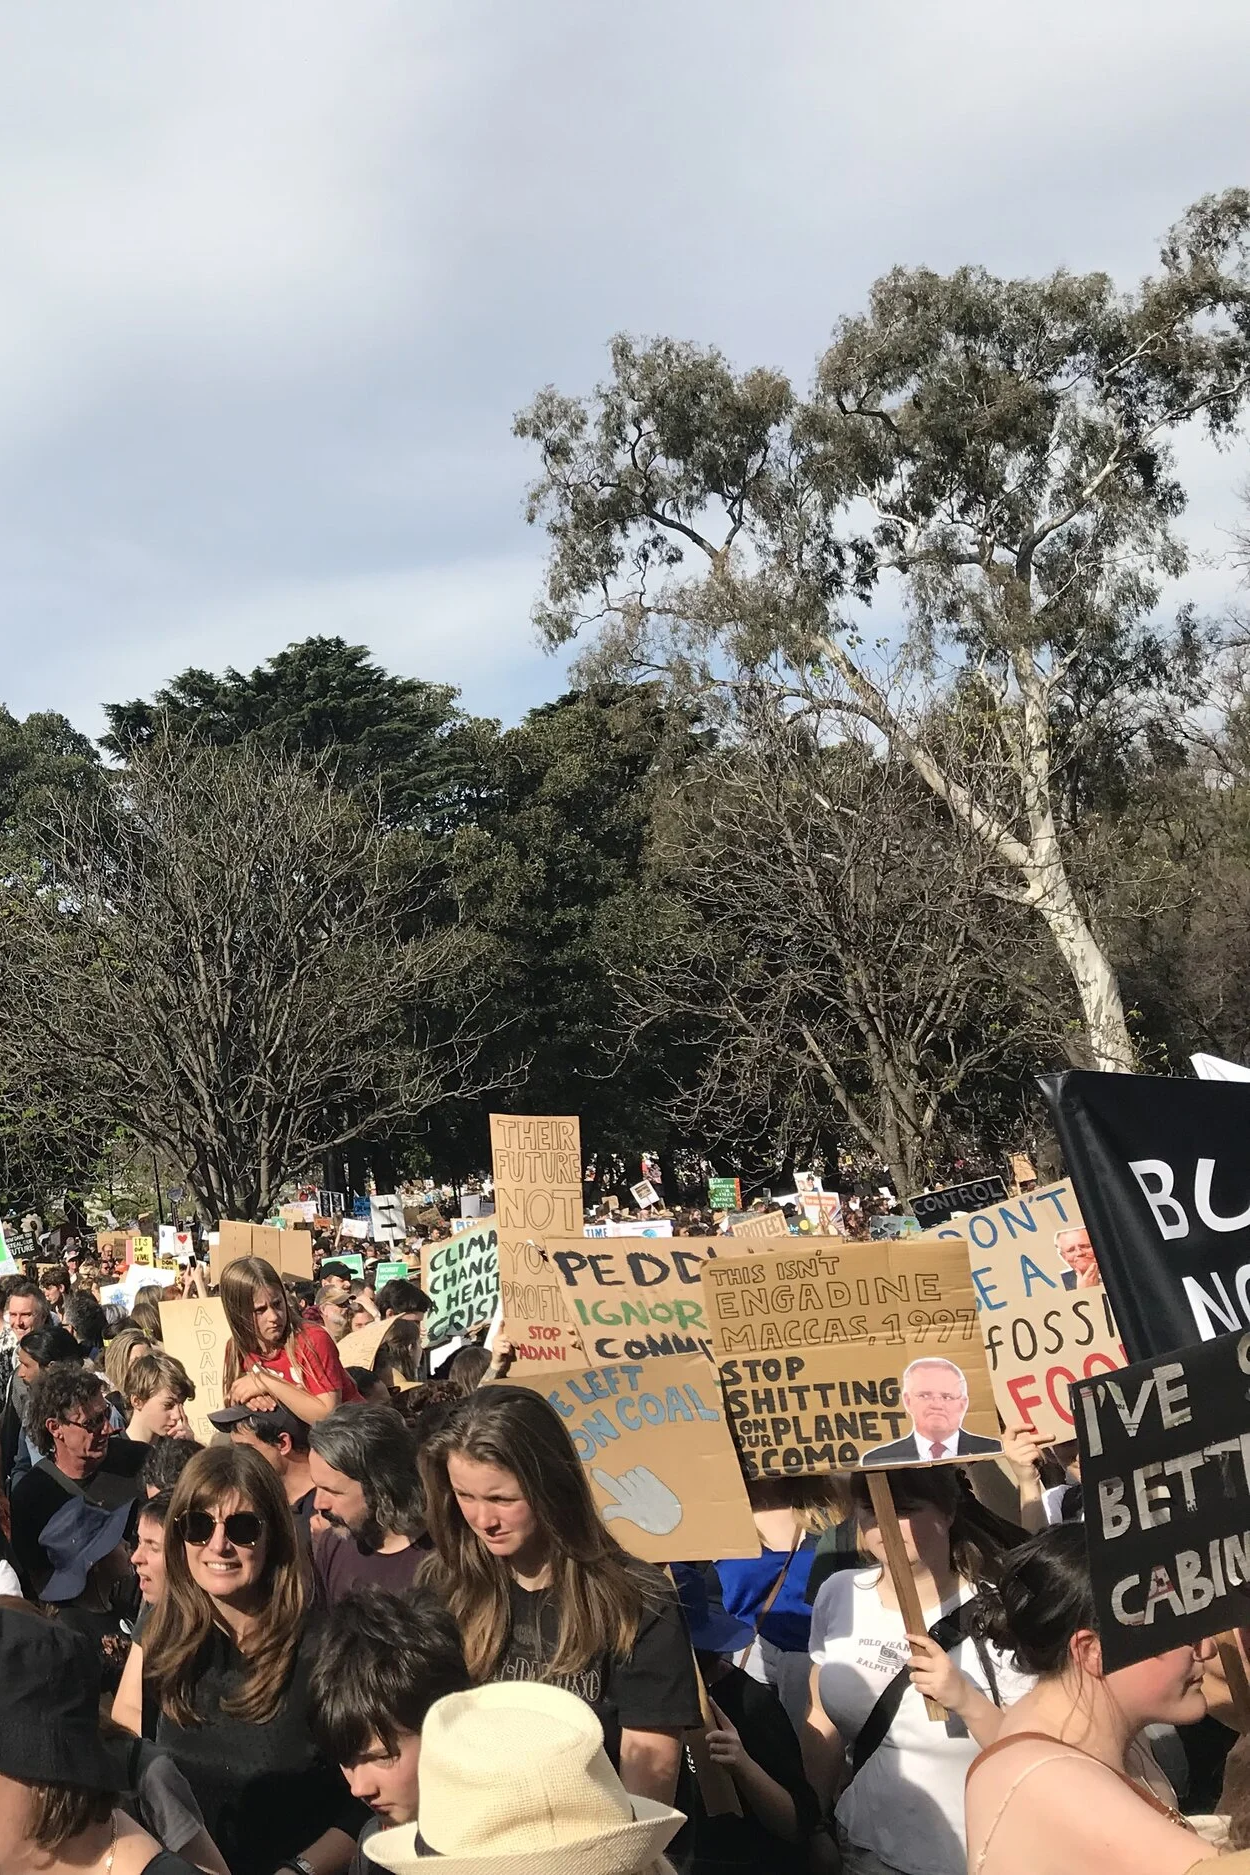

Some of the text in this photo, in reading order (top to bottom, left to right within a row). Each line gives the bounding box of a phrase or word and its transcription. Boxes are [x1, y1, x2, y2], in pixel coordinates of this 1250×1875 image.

[497, 1120, 575, 1150] THEIR
[495, 1149, 581, 1183] FUTURE
[498, 1188, 582, 1231] NOT
[913, 1182, 1004, 1215] CONTROL
[10, 1244, 35, 1256] UTURE
[586, 1228, 608, 1238] TIME
[430, 1230, 498, 1272] CLIMA
[502, 1242, 554, 1275] YO
[553, 1247, 716, 1287] PEDD
[709, 1250, 839, 1286] THIS ISN'T
[430, 1252, 497, 1294] CHANG
[971, 1254, 1057, 1312] E A
[427, 1272, 500, 1319] A HEALT
[716, 1273, 941, 1319] ENGADINE
[428, 1294, 498, 1340] CRISI
[573, 1298, 708, 1330] IGNOR
[529, 1326, 561, 1341] STOP
[519, 1344, 566, 1360] ADANI
[566, 1365, 643, 1404] LEFT
[721, 1357, 805, 1386] STOP
[729, 1377, 900, 1419] SHITTING
[1080, 1362, 1193, 1458] I'VE
[570, 1384, 720, 1461] ON COAL
[740, 1411, 906, 1446] ON PLANET
[737, 1434, 772, 1449] OUR
[747, 1443, 860, 1478] SCOMO
[1111, 1530, 1250, 1626] CABIN
[859, 1638, 881, 1647] POLO
[856, 1657, 887, 1674] RALPH
